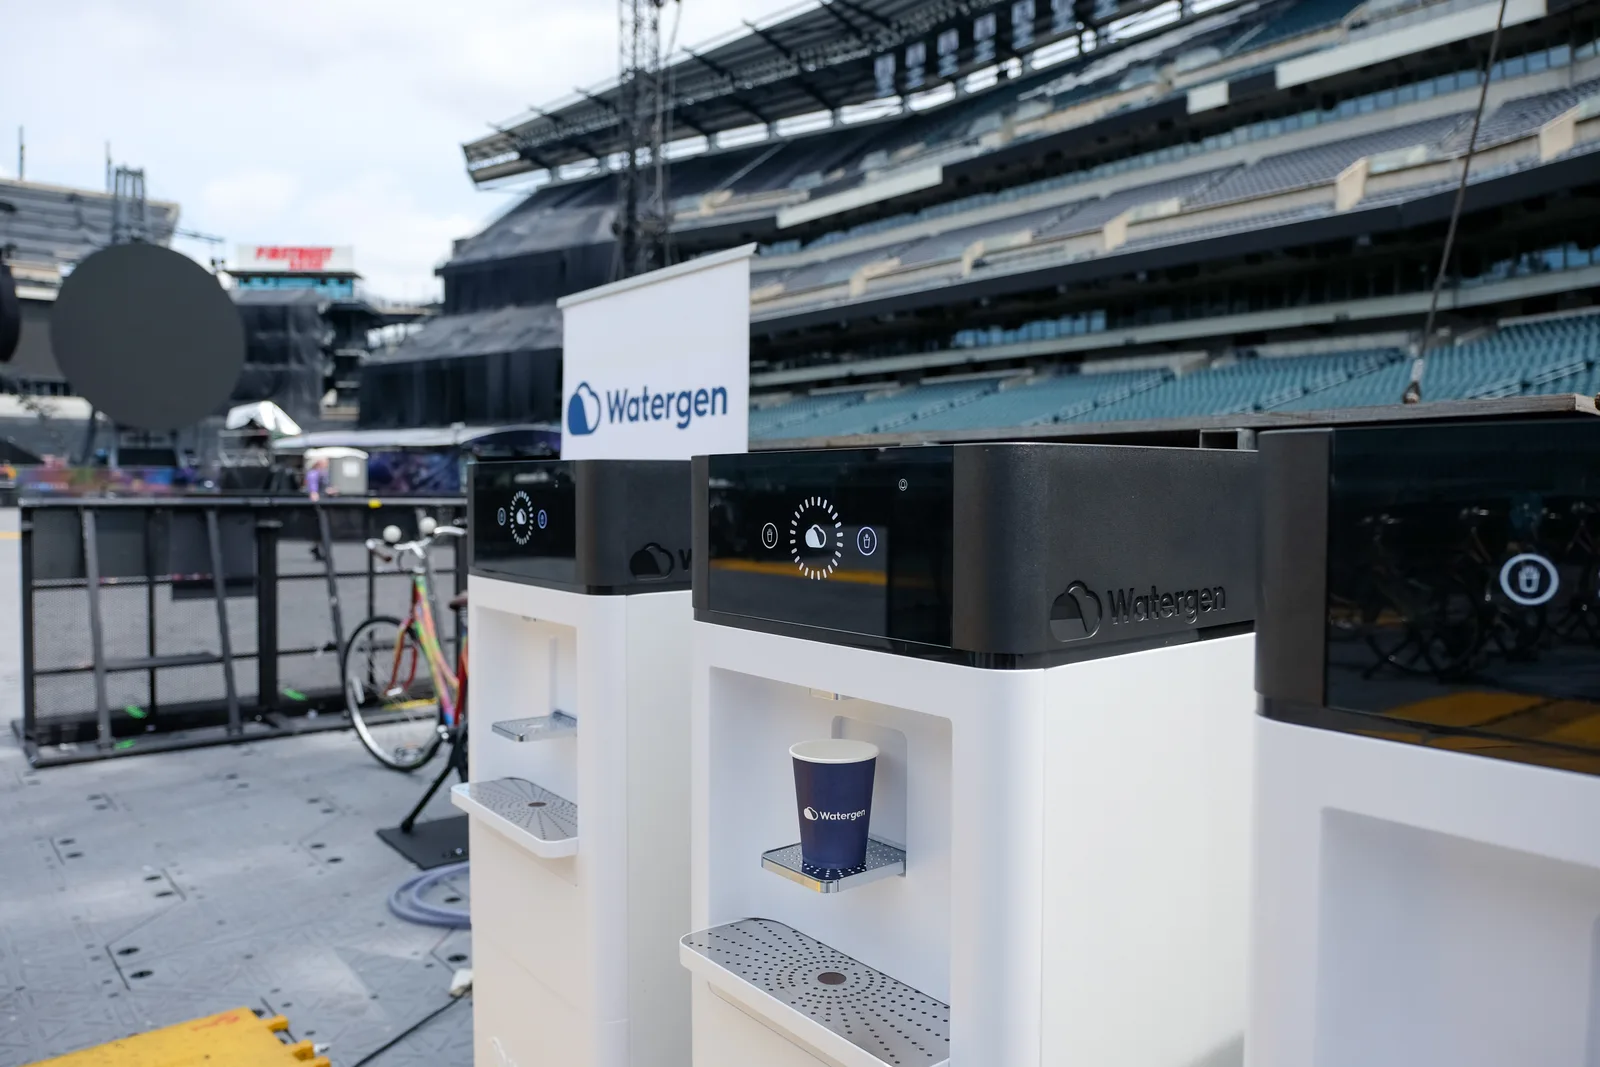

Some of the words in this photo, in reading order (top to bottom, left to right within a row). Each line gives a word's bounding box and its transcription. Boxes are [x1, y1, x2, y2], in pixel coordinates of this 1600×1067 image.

[606, 385, 728, 429] Watergen
[1107, 585, 1226, 625] Watergen
[819, 809, 866, 821] Watergen
